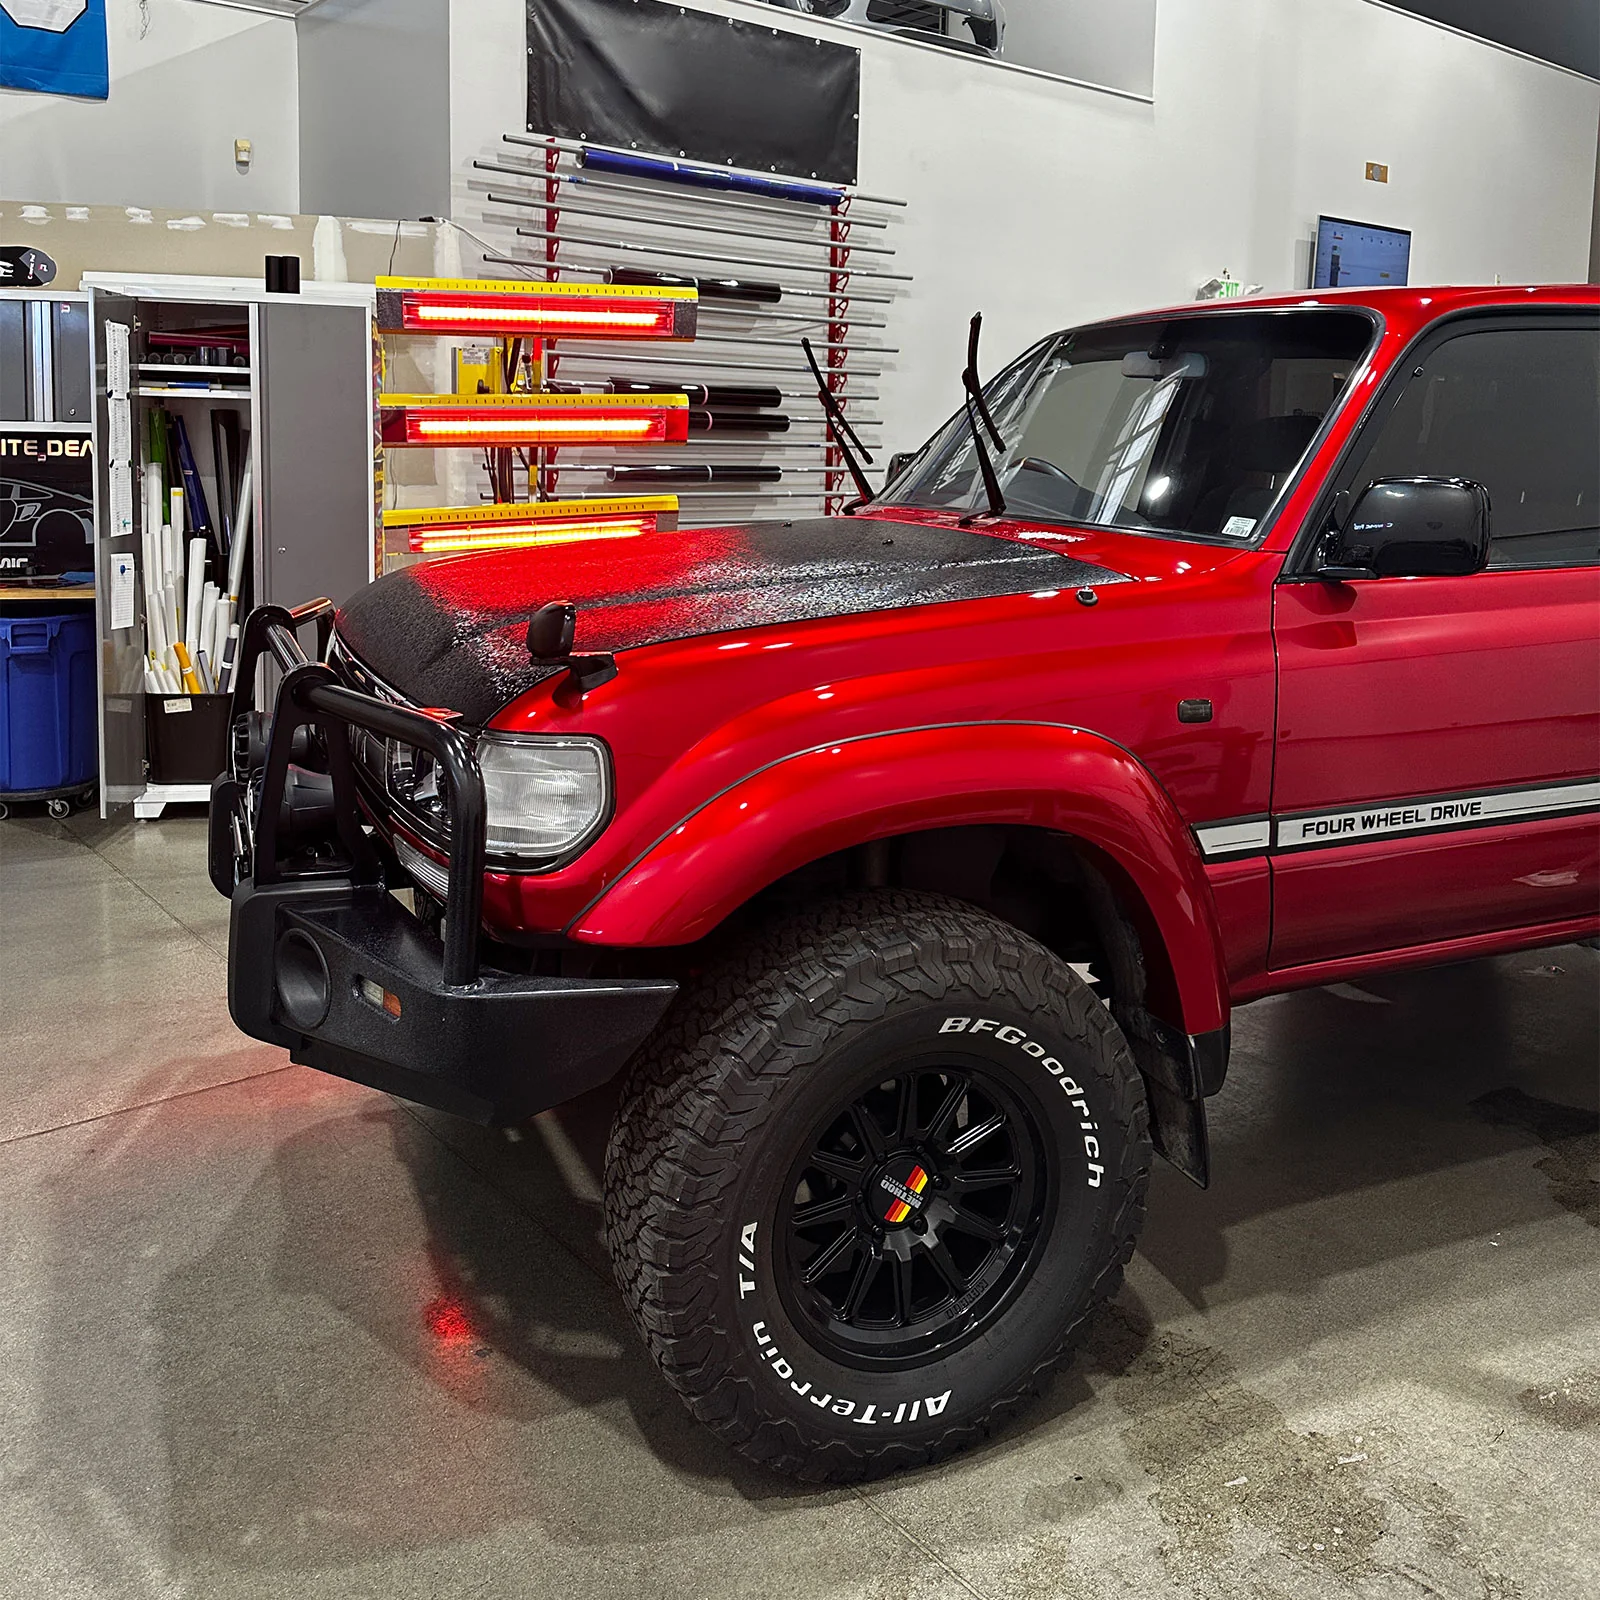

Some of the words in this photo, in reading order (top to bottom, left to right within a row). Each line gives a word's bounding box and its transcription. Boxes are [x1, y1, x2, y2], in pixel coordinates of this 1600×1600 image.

[1302, 817, 1356, 838] FOUR
[1361, 809, 1426, 831] WHEEL
[1430, 801, 1482, 821] DRIVE
[938, 1017, 1105, 1188] BFGoodrich
[880, 1179, 922, 1209] METHOD
[738, 1222, 758, 1300] T/A
[752, 1321, 952, 1425] All-Terrain
